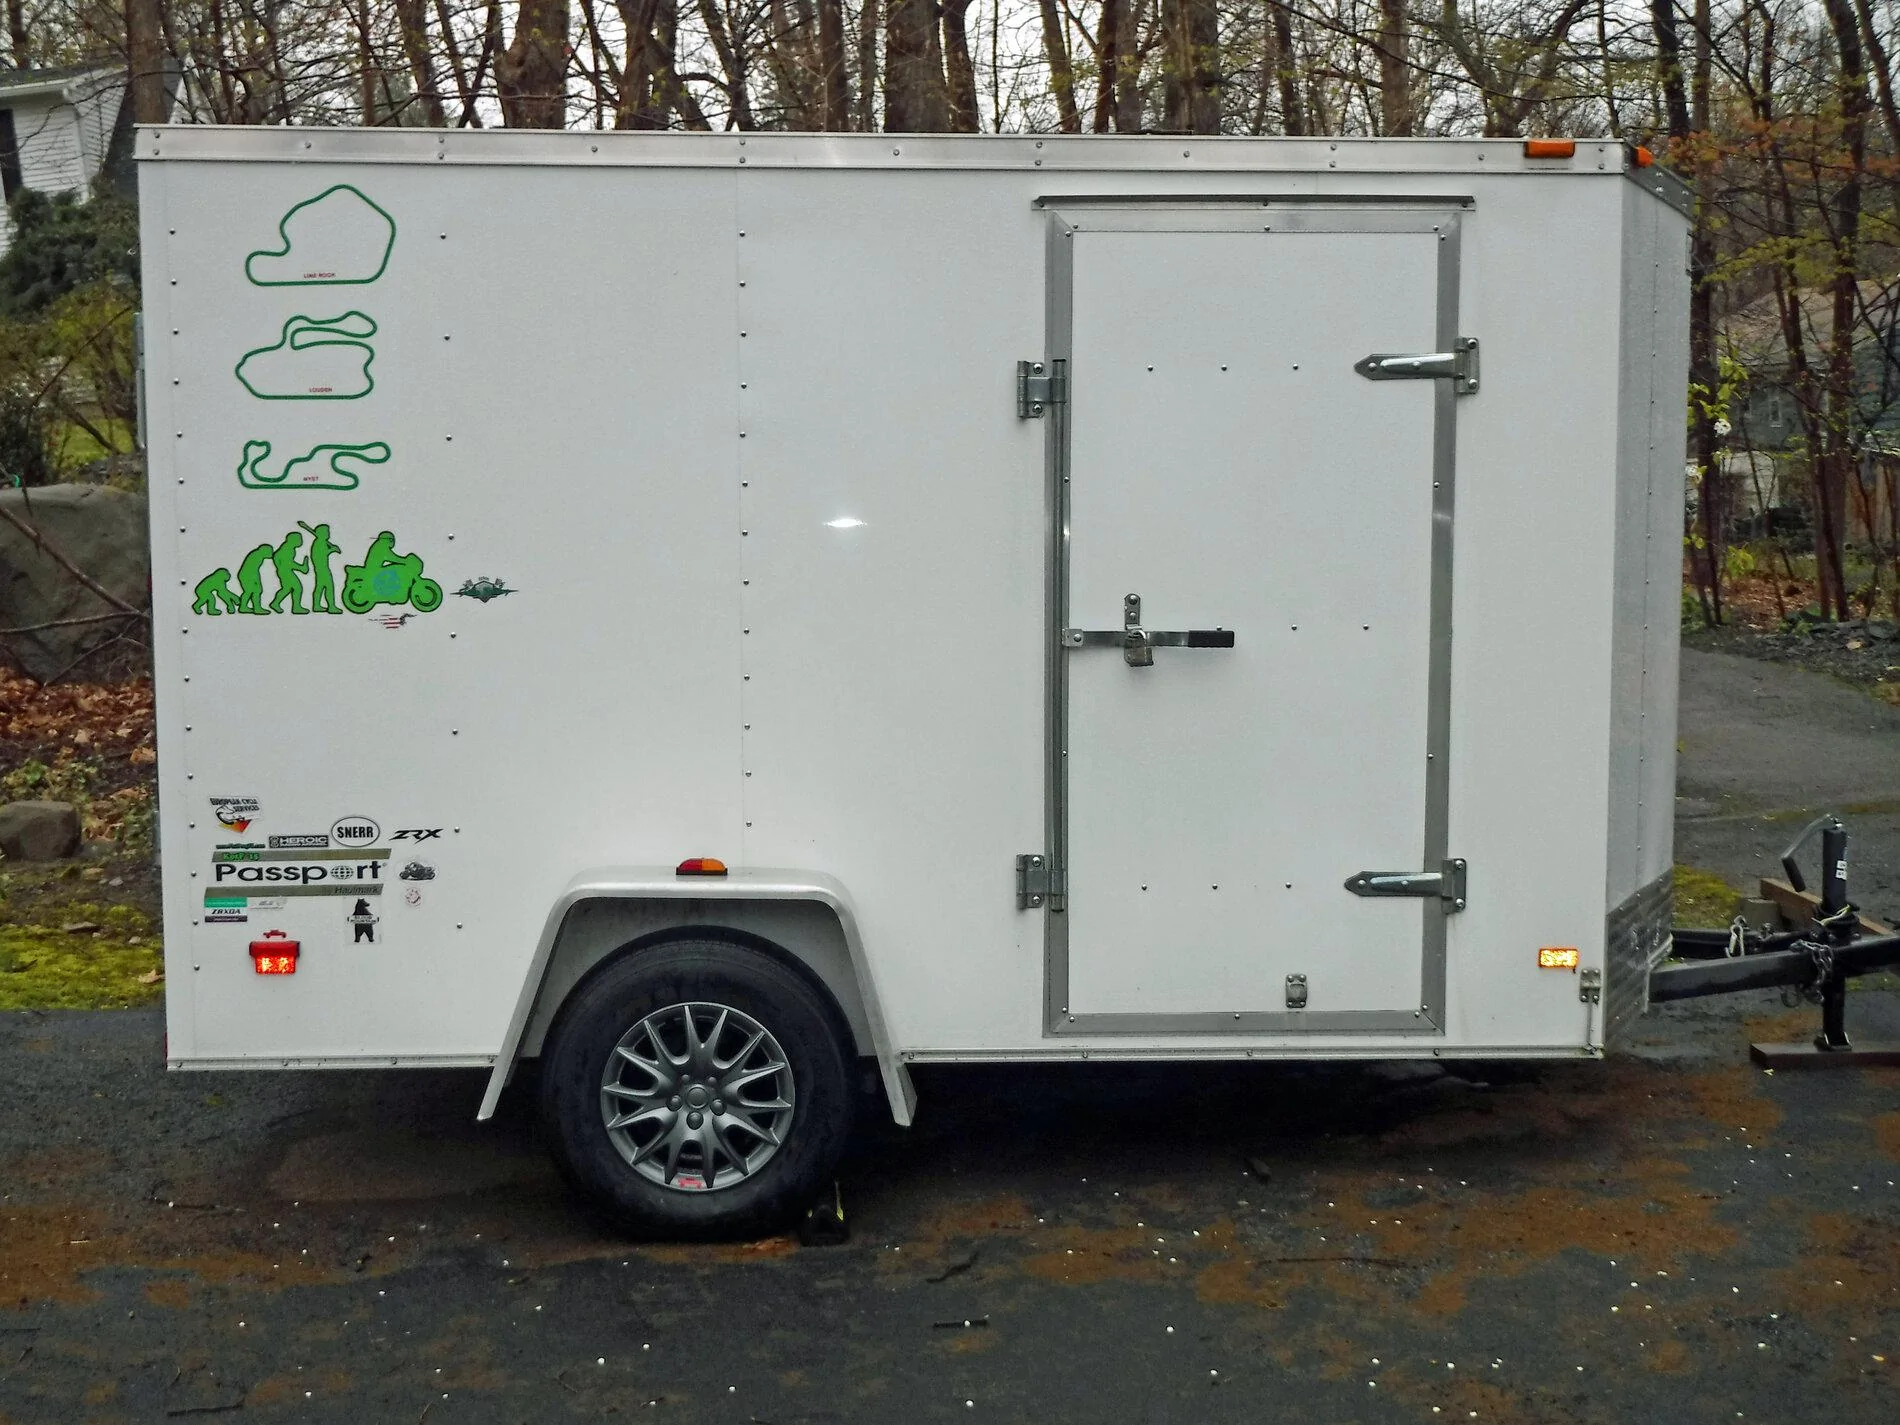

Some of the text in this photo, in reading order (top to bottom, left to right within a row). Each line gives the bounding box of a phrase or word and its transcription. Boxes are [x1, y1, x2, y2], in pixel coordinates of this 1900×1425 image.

[337, 826, 374, 839] SNERR
[389, 828, 444, 845] ZRX
[279, 836, 328, 844] HEROIC
